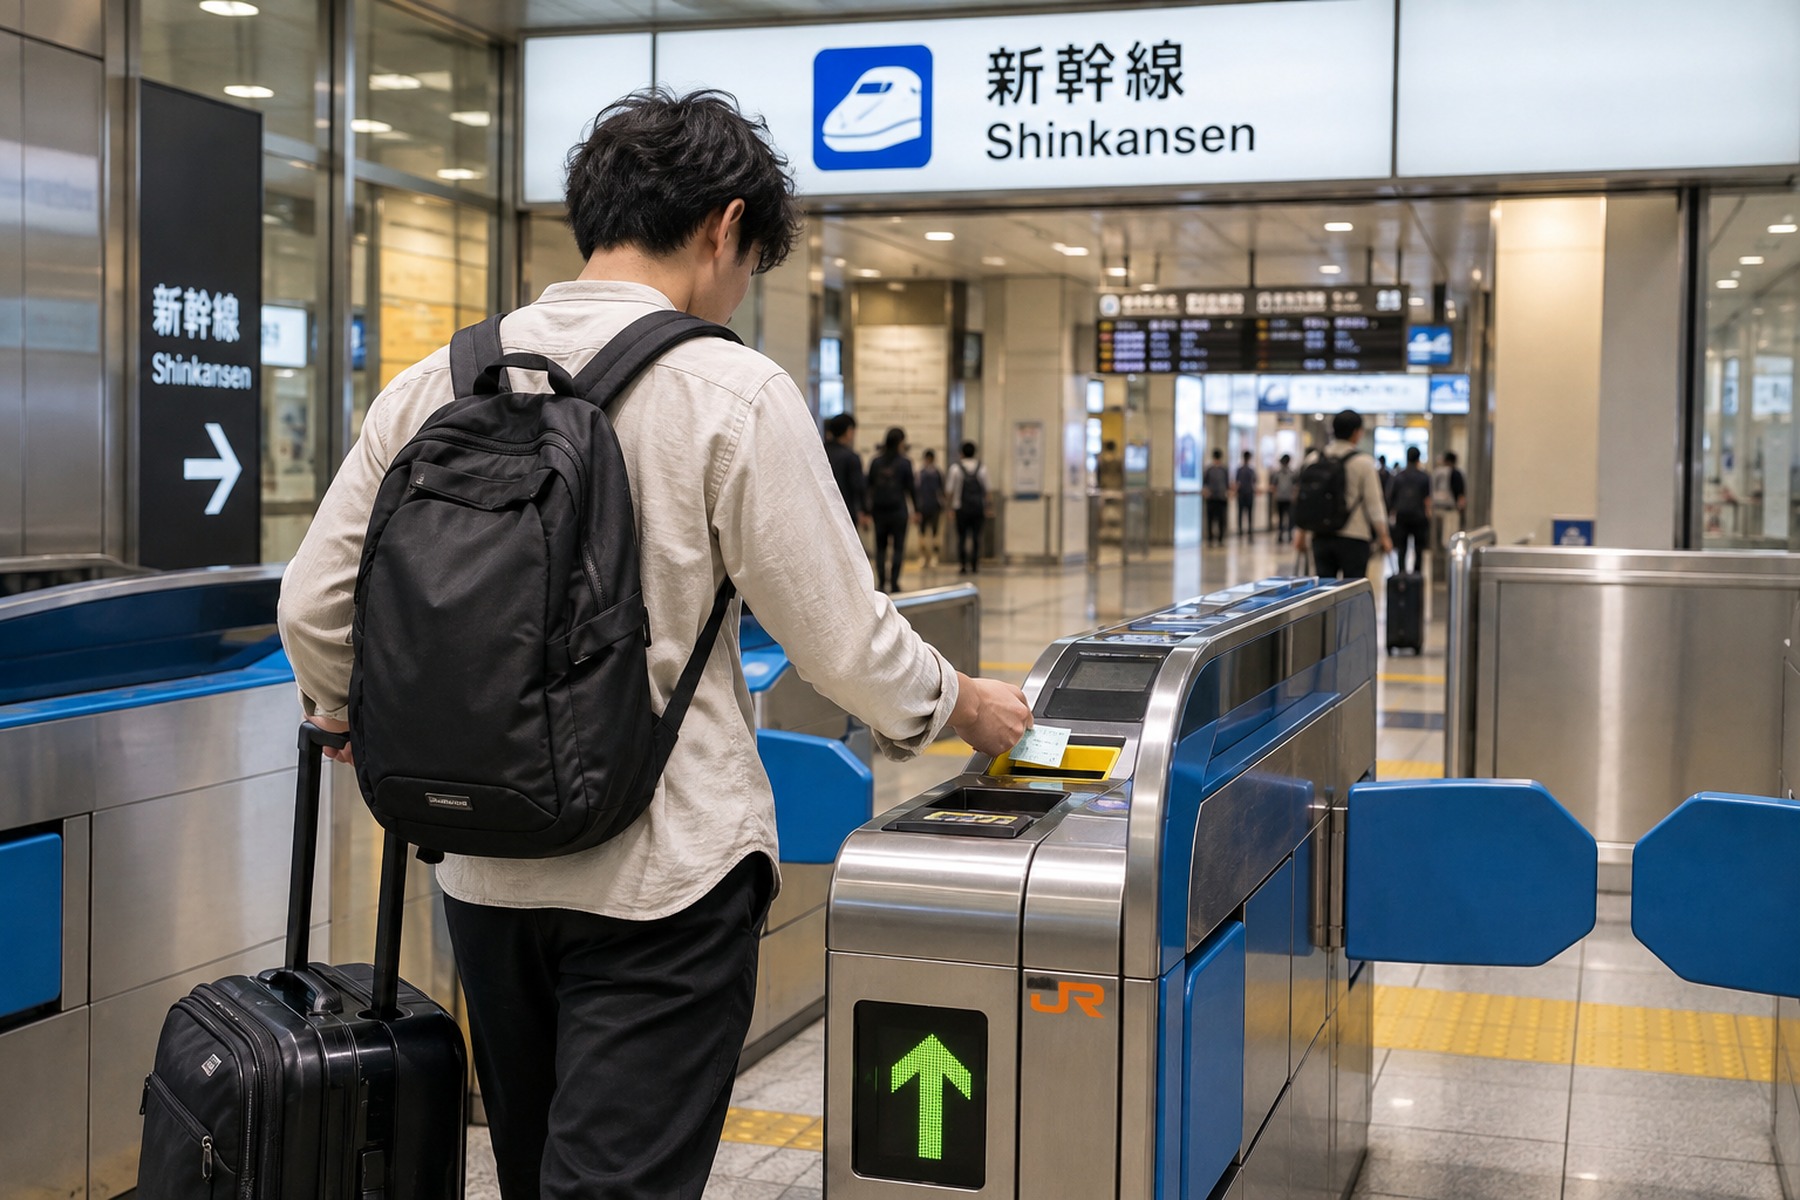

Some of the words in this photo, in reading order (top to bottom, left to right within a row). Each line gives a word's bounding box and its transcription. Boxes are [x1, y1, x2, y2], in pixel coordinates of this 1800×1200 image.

[987, 39, 1184, 107] 新幹線
[986, 119, 1255, 160] Shinkansen
[152, 283, 240, 343] 新幹線
[152, 352, 252, 390] Shinkansen
[1030, 981, 1105, 1019] JR
